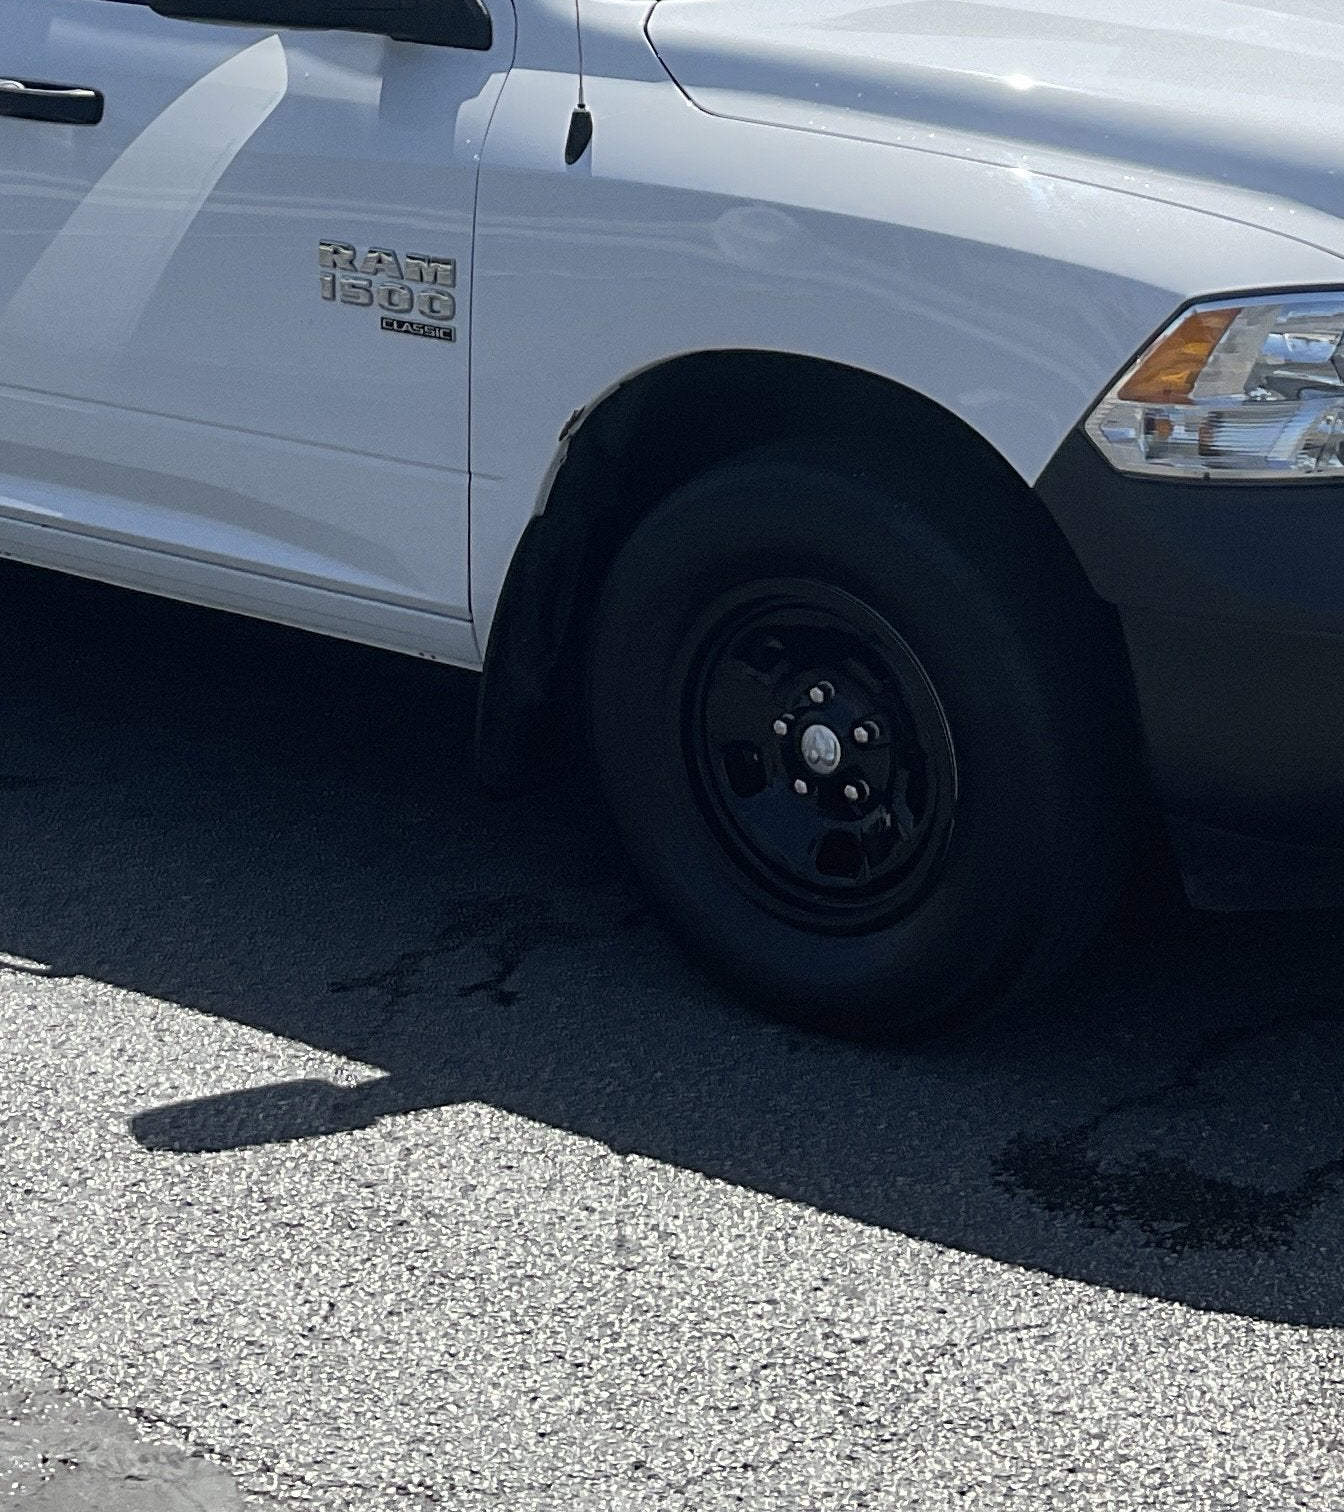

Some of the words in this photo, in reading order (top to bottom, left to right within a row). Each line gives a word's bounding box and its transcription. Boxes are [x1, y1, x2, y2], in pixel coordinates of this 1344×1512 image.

[318, 239, 456, 288] RAM
[319, 271, 456, 321] 1500
[381, 317, 454, 340] CLASSIC
